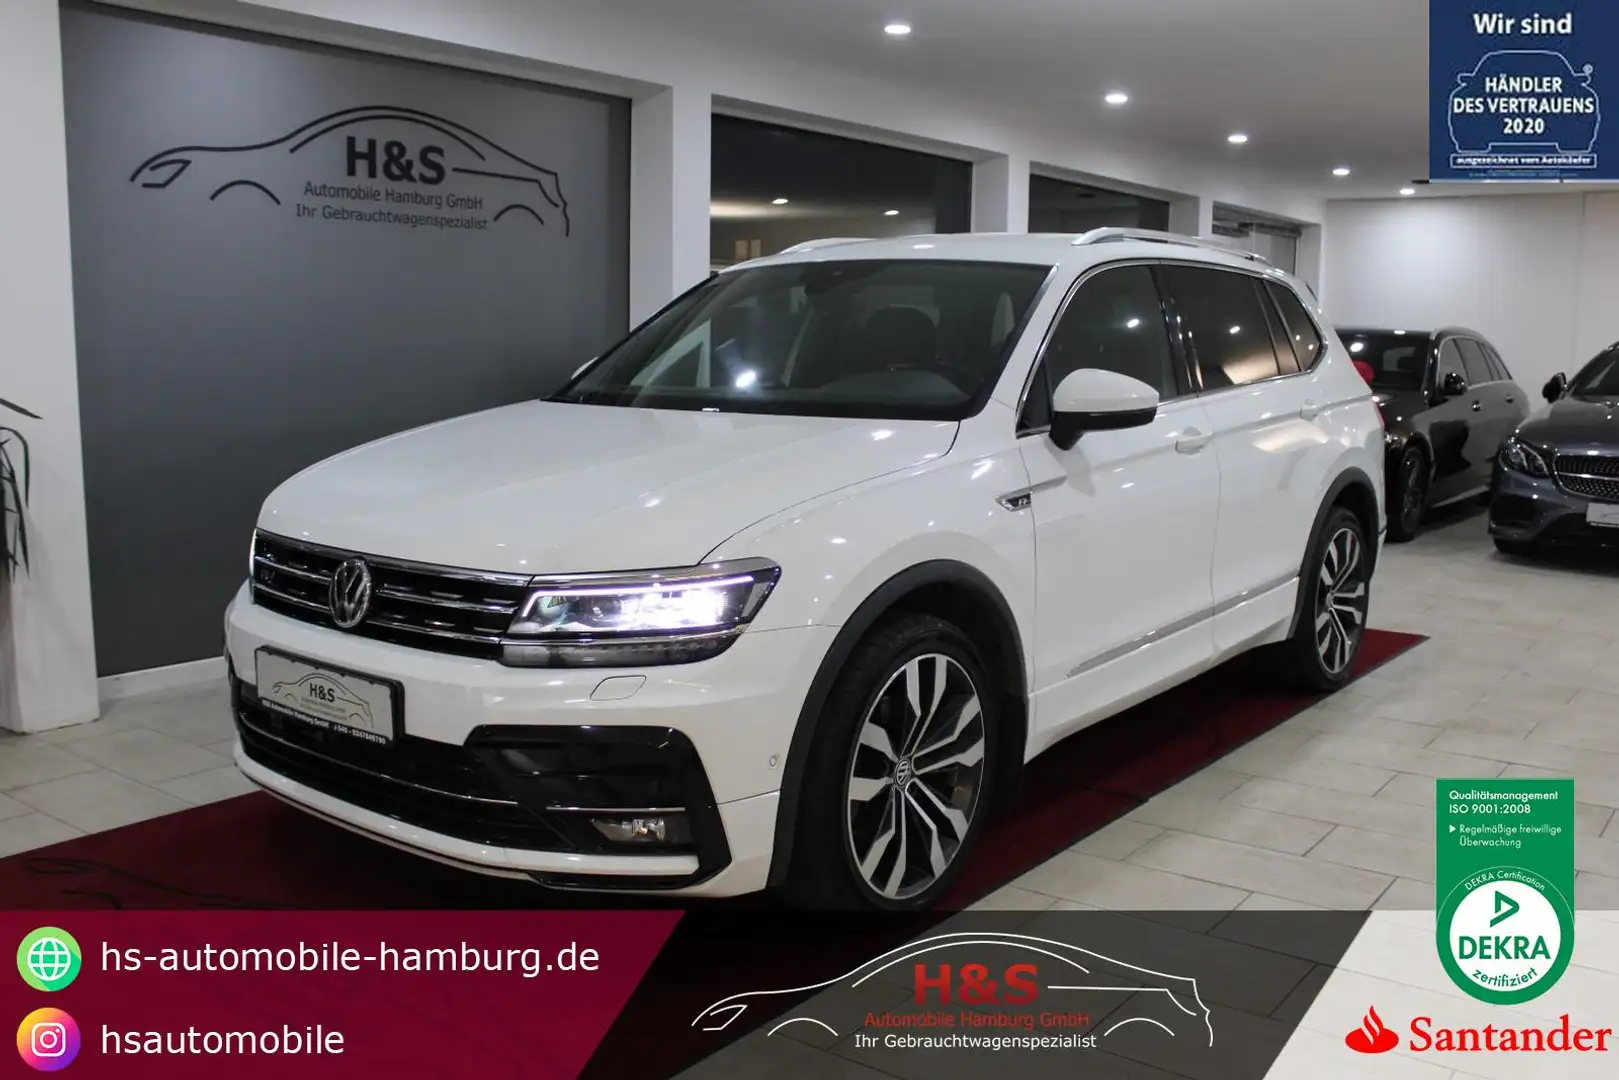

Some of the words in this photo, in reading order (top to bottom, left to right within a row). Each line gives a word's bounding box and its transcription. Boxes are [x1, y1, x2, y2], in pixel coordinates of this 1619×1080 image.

[346, 135, 446, 185] H&S
[304, 181, 381, 201] Automobile
[385, 187, 442, 209] Hamburg
[446, 193, 483, 210] GmbH
[296, 203, 317, 218] Ihr
[322, 205, 488, 231] Gebrauchtwagenspezialist
[309, 683, 335, 703] H&S
